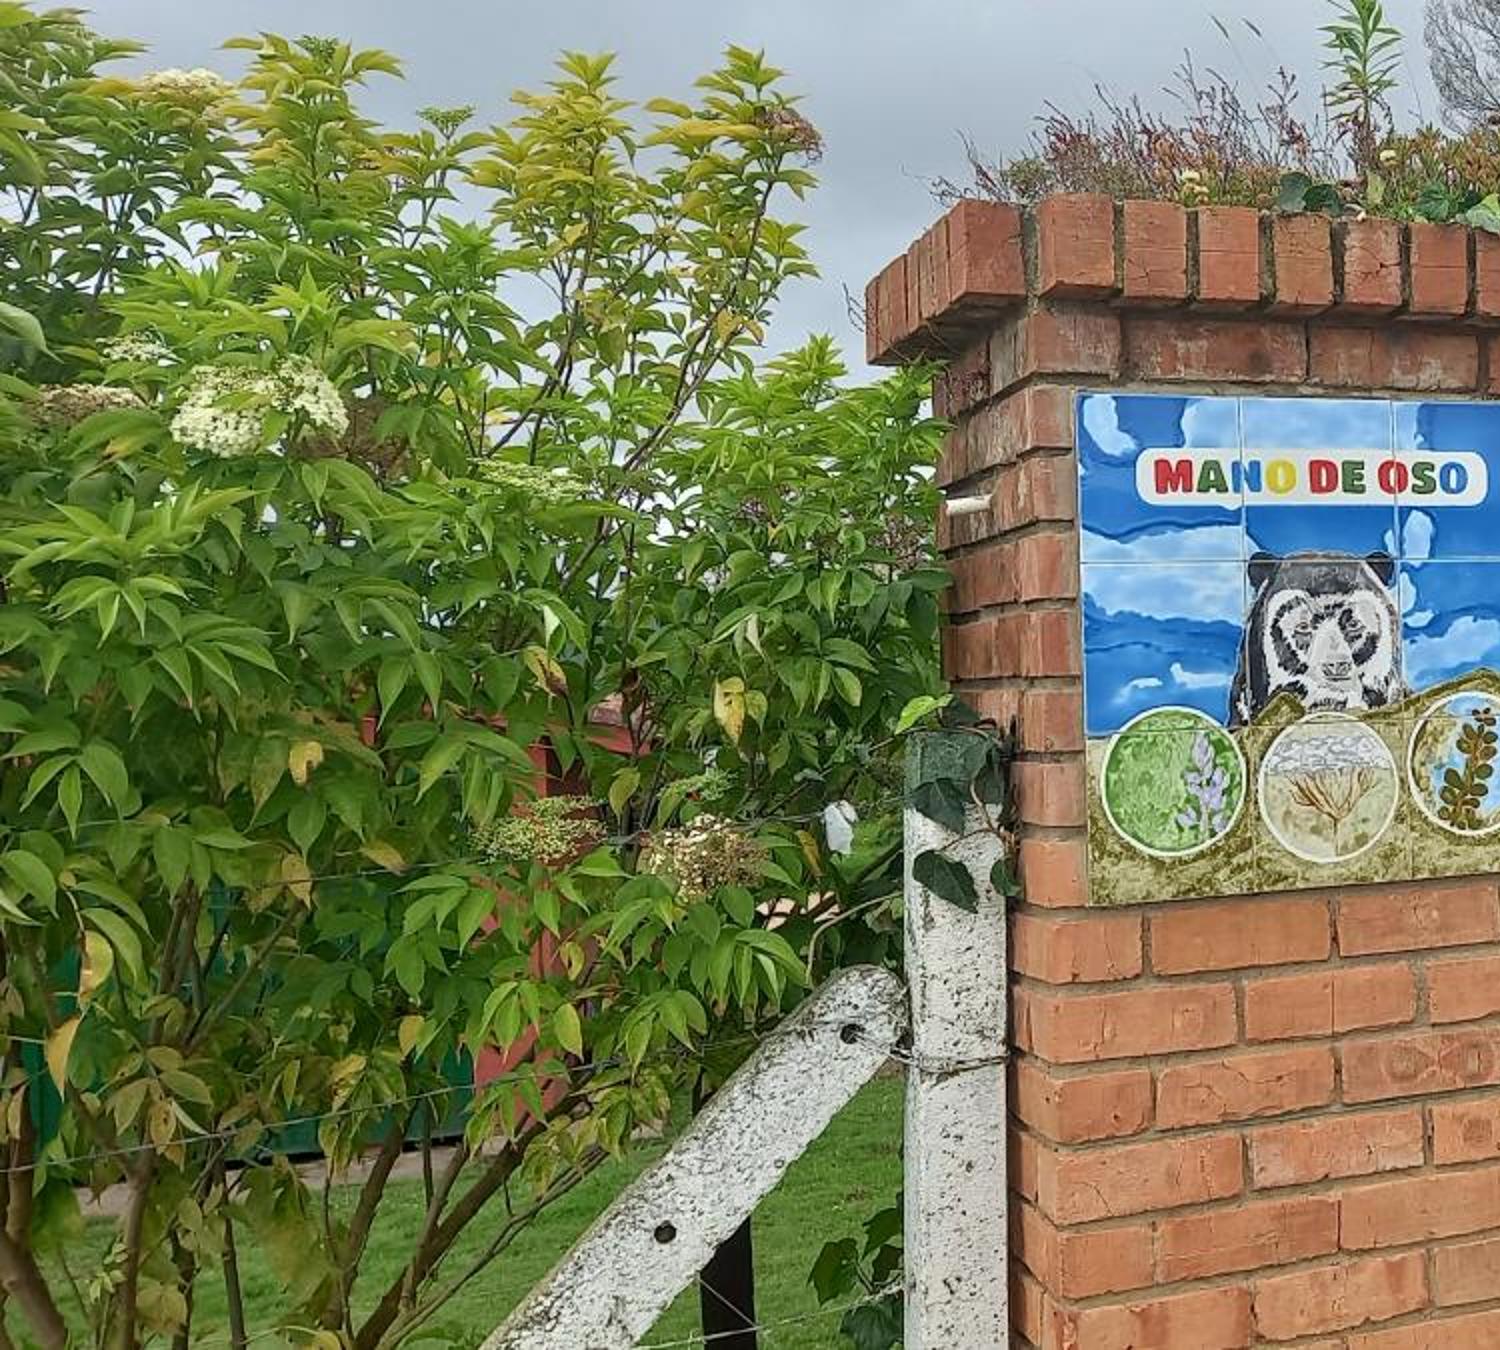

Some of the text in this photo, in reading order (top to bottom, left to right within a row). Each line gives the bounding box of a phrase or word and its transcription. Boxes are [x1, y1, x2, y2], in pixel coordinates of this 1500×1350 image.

[1154, 459, 1468, 494] MANO DE OSO
